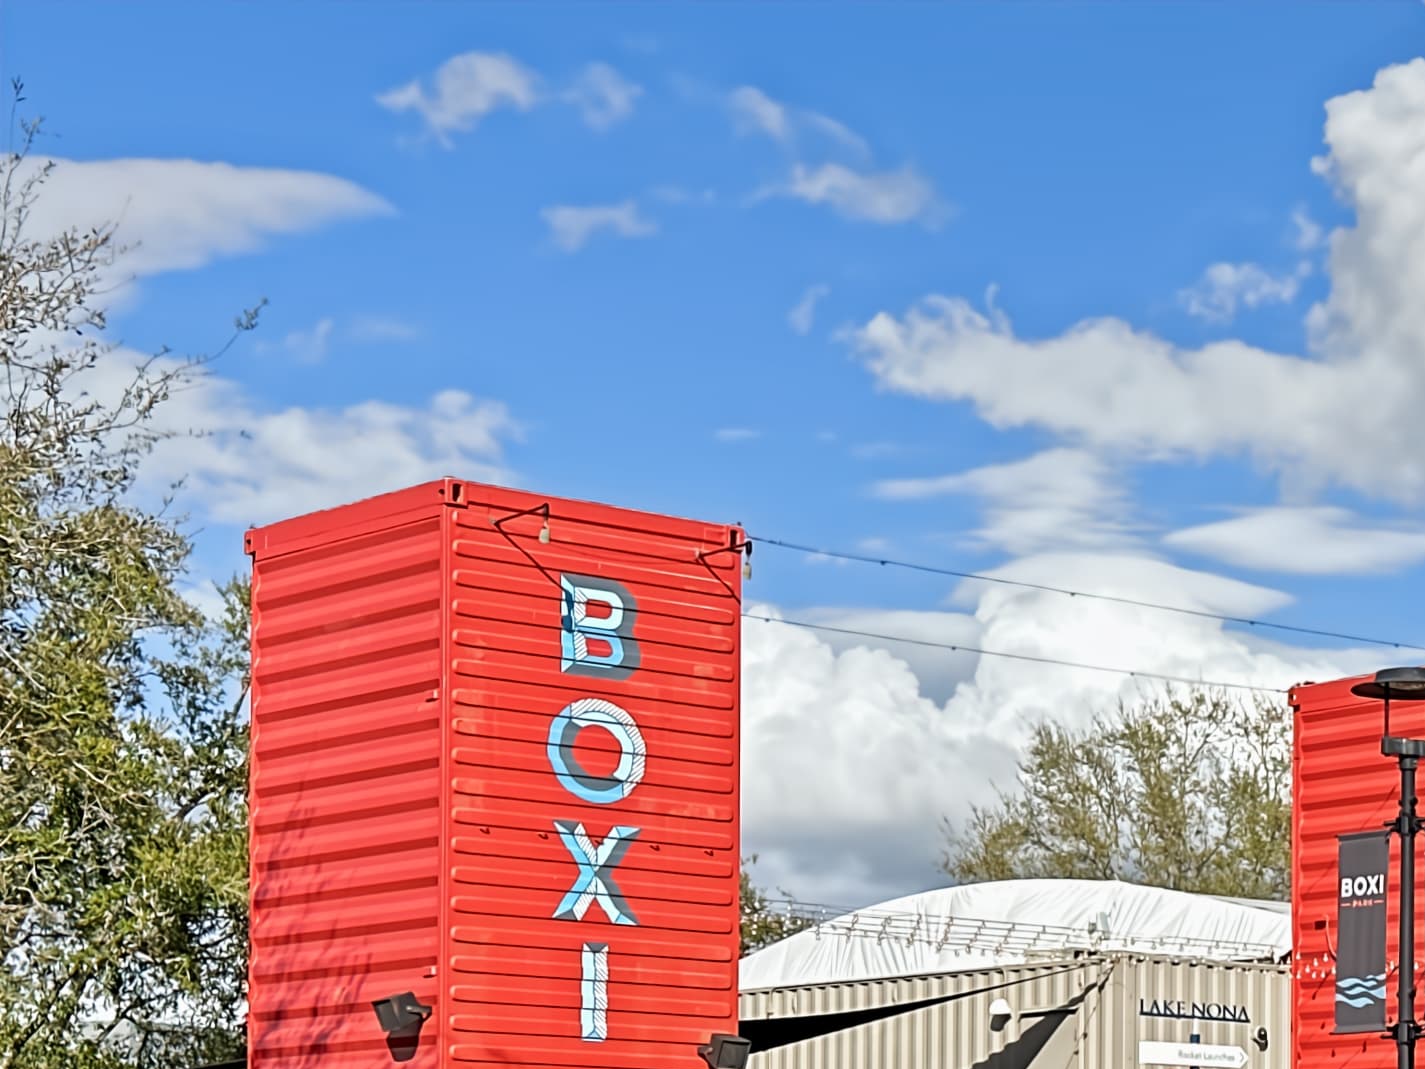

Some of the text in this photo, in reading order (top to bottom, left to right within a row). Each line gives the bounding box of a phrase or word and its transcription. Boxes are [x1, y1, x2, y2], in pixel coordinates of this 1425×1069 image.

[547, 573, 647, 1042] BOXI
[1341, 874, 1384, 898] BOXI
[1353, 899, 1373, 908] PARK
[1139, 998, 1250, 1023] LAKE NONA
